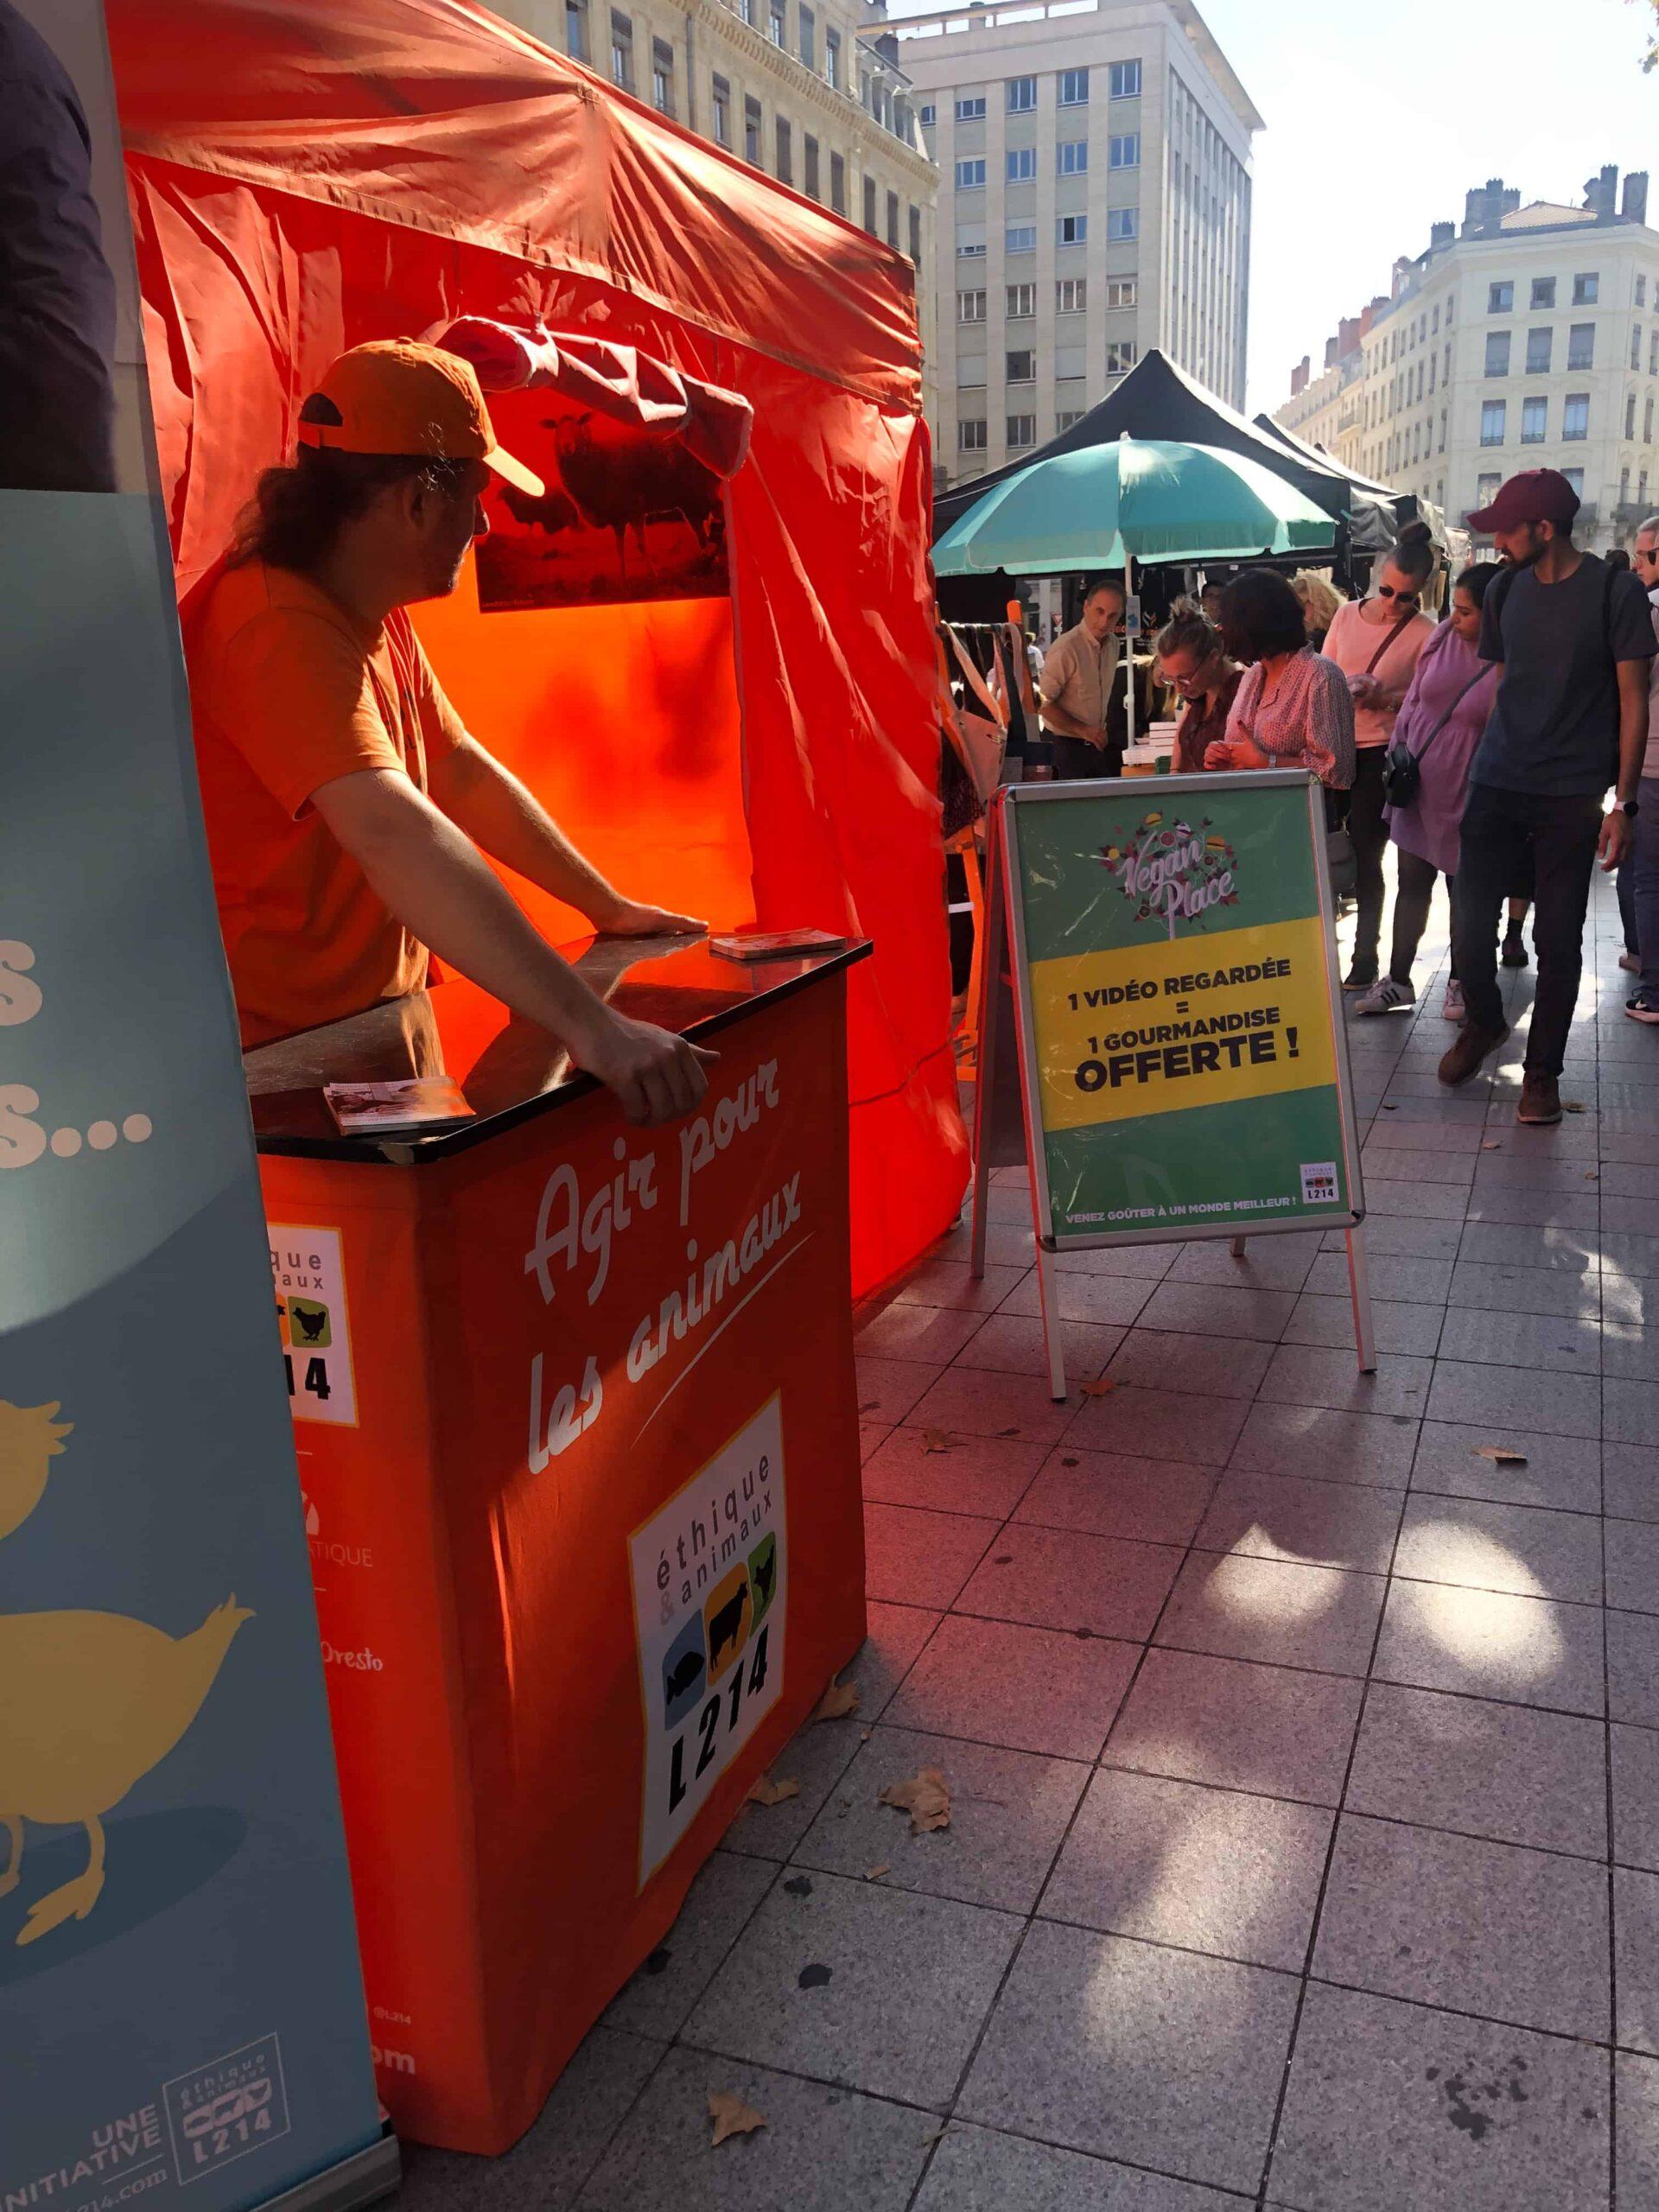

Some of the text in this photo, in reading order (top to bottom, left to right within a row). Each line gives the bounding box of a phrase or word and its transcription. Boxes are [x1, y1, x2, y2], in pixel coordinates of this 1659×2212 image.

[1116, 830, 1203, 906] Vegan
[1163, 872, 1235, 940] Place
[1068, 957, 1291, 1011] 1 VIDÉO REGARDÉE
[1074, 1030, 1276, 1093] OFFERTE
[1088, 1007, 1281, 1053] 1 GOURMANDISE
[524, 1058, 779, 1306] Agir pour
[1065, 1211, 1105, 1224] VENEZ
[1108, 1207, 1155, 1220] GOÛTER
[1159, 1205, 1166, 1217] À
[1169, 1205, 1186, 1216] UN
[1188, 1202, 1231, 1214] MONDE
[1234, 1197, 1290, 1211] MEILLEUR
[1308, 1189, 1334, 1199] L214
[274, 1274, 323, 1290] aux
[528, 1170, 801, 1475] les animaux
[657, 1454, 770, 1591] éthique
[682, 1489, 772, 1605] animaux
[668, 1623, 769, 1816] L214
[92, 2104, 156, 2148] UNE
[194, 2107, 272, 2164] L214
[0, 2128, 162, 2212] NITIATIVE
[66, 2169, 168, 2212] 214.com
